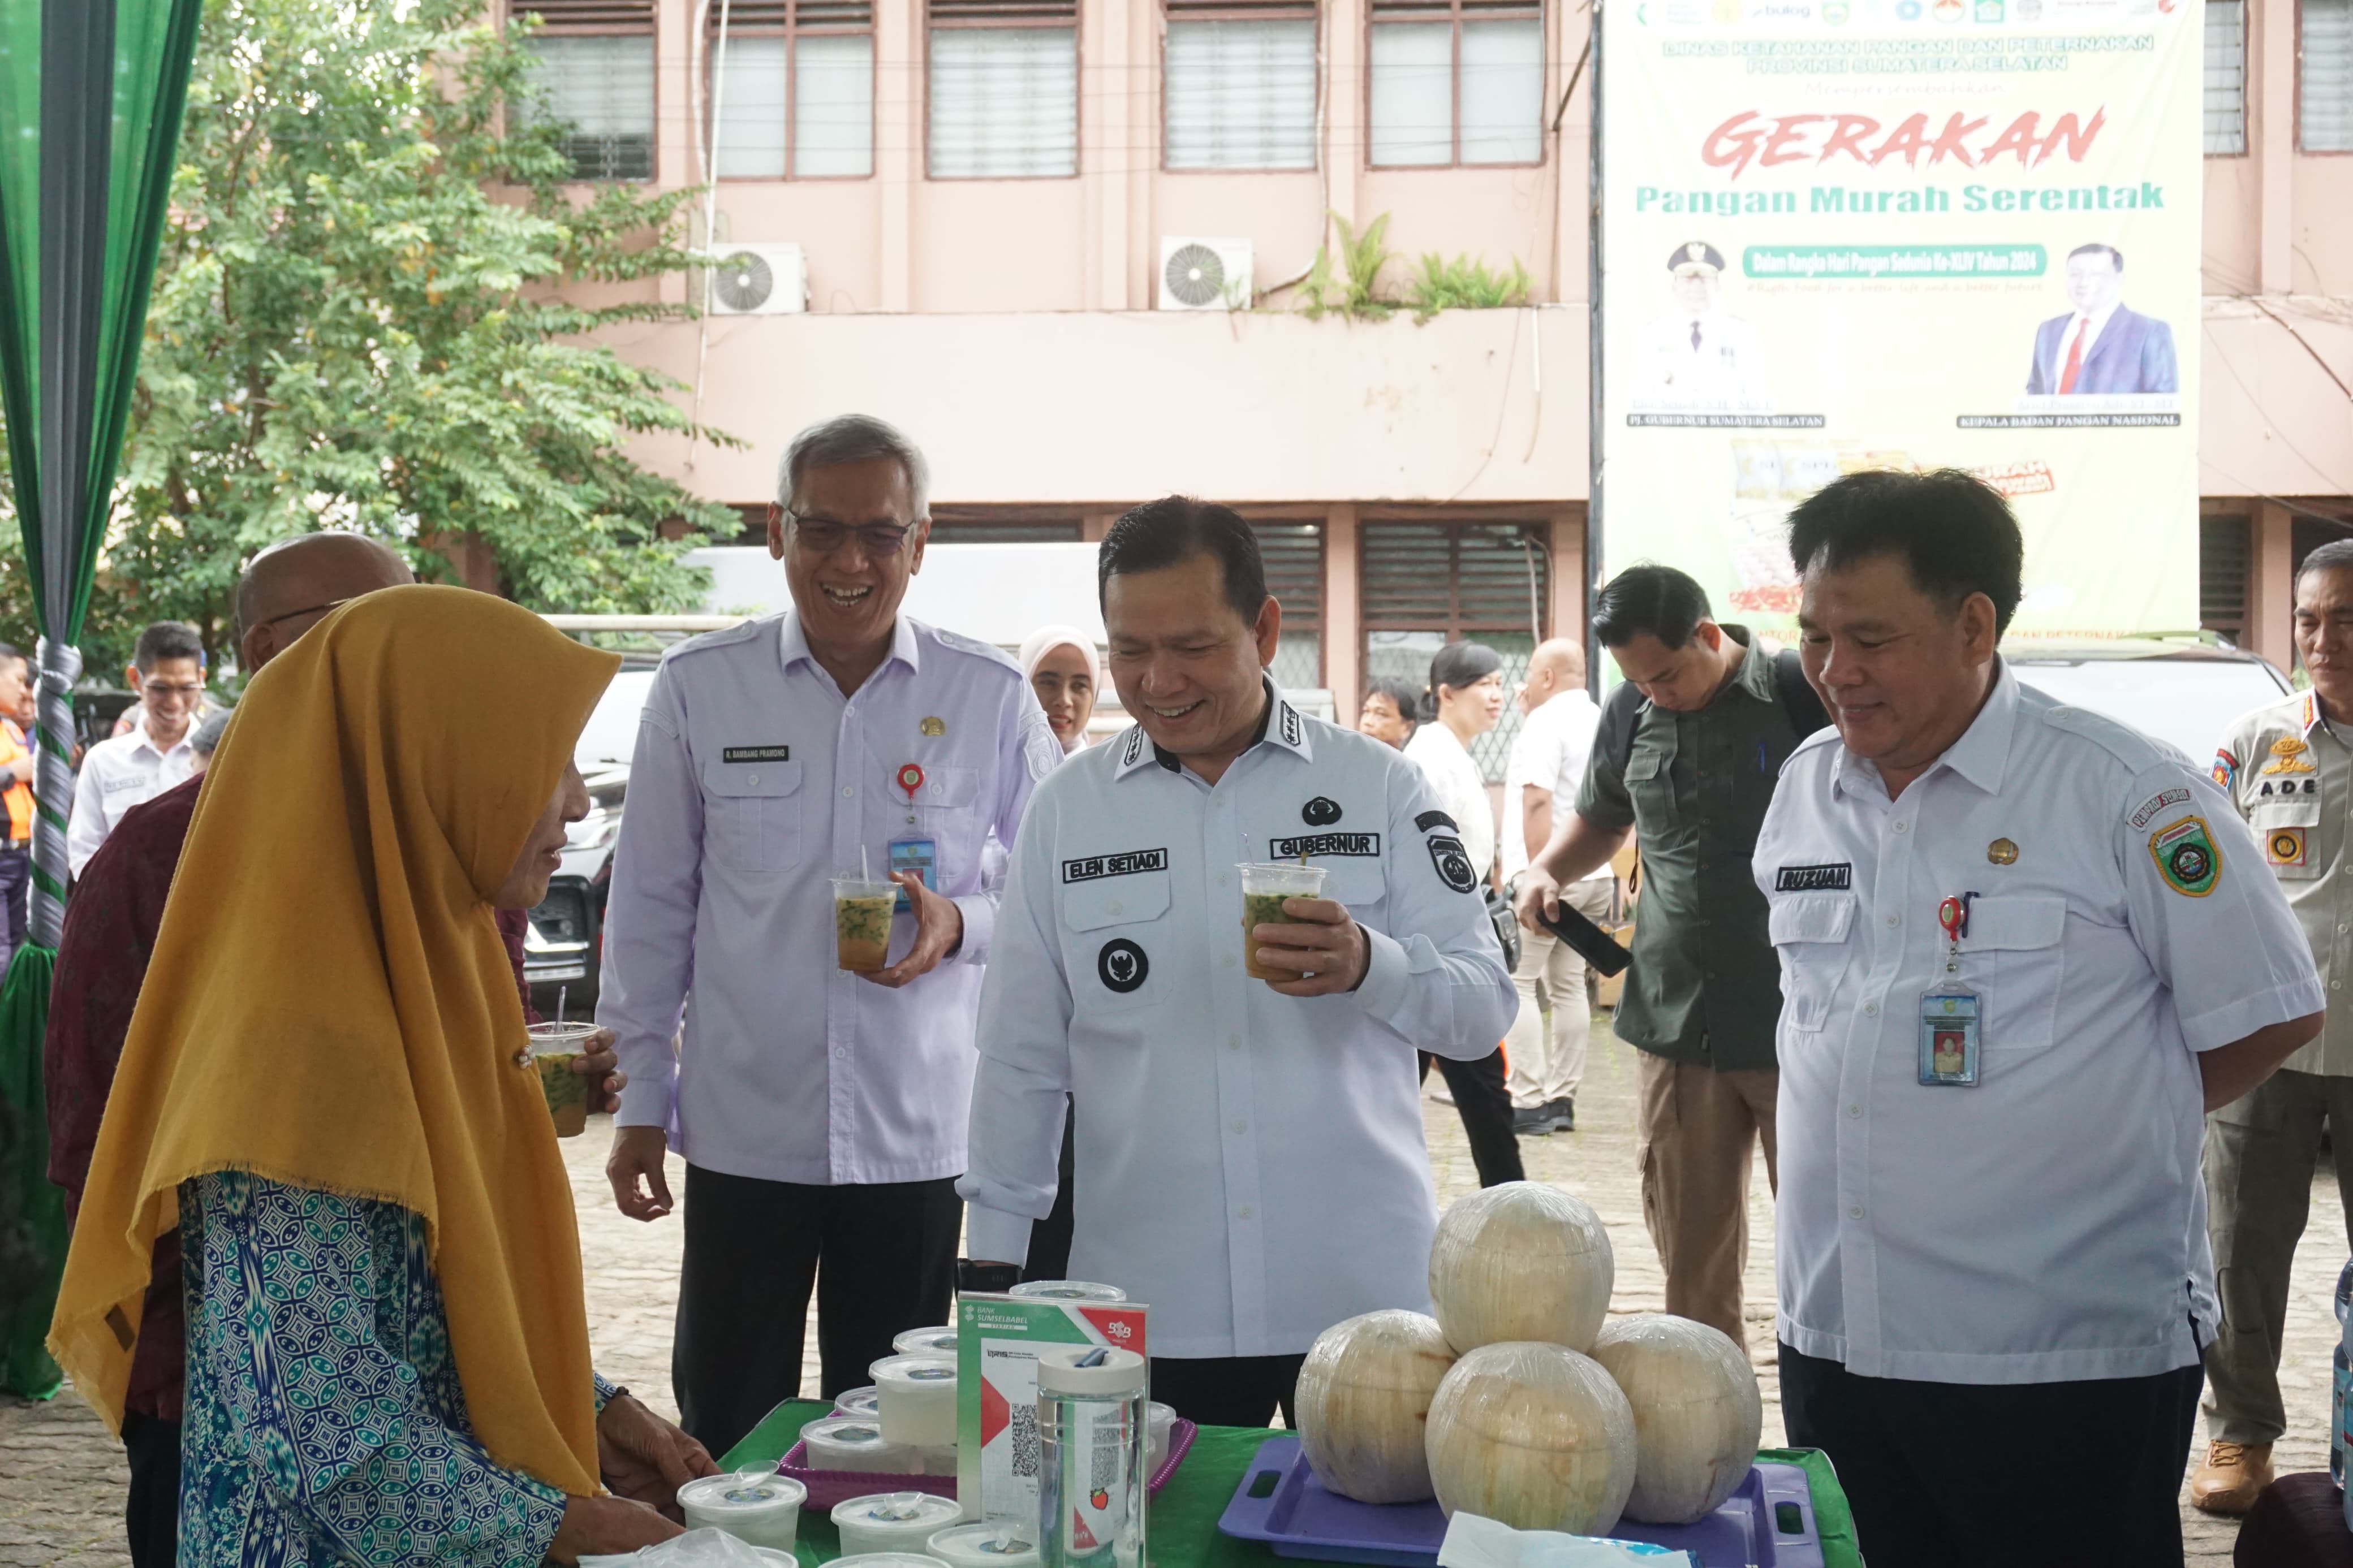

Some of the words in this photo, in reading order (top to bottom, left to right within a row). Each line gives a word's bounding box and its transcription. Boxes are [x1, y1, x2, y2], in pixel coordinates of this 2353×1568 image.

[1764, 4, 1811, 18] bulog
[1663, 40, 1728, 57] DINAS
[1732, 39, 1860, 56] KETAHANAN
[1864, 38, 1953, 55] PANGAN
[1957, 37, 2004, 54] DAN
[2008, 35, 2154, 53] PETERNAKAN
[1747, 58, 1848, 75] PROVINSI
[1851, 57, 1974, 74] SUMATERA
[1974, 55, 2068, 72] SELATAN
[1700, 102, 2106, 182] GERAKAN
[1636, 184, 1796, 217] Pangan
[1810, 184, 1950, 213] Murah
[1963, 181, 2164, 213] Serentak
[1753, 252, 1786, 272] Dalam
[1787, 252, 1825, 277] Rangka
[1827, 252, 1849, 271] Hari
[1851, 252, 1889, 277] Pangan
[1890, 251, 1932, 272] Sedunia
[1976, 251, 2008, 271] Tahun
[2010, 250, 2036, 271] 2024
[1645, 416, 1707, 425] GUBERNUR
[1710, 416, 1770, 425] SUMATERA
[1772, 417, 1823, 426] SELATAN
[1961, 417, 2009, 426] KEPALA
[2012, 416, 2054, 426] BADAN
[2057, 416, 2110, 426] PANGAN
[2112, 414, 2178, 425] NASIONAL
[732, 750, 758, 758] BAMBANG
[759, 749, 785, 758] PRAMONO
[2260, 780, 2316, 797] ADE
[1280, 835, 1370, 856] GUBERNUR
[1070, 859, 1103, 879] ELEN
[1108, 852, 1160, 873] SETIADI
[1783, 868, 1847, 887] RUZUAN
[977, 1314, 1028, 1324] SUMSELBABEL
[987, 1349, 1008, 1358] QRIS
